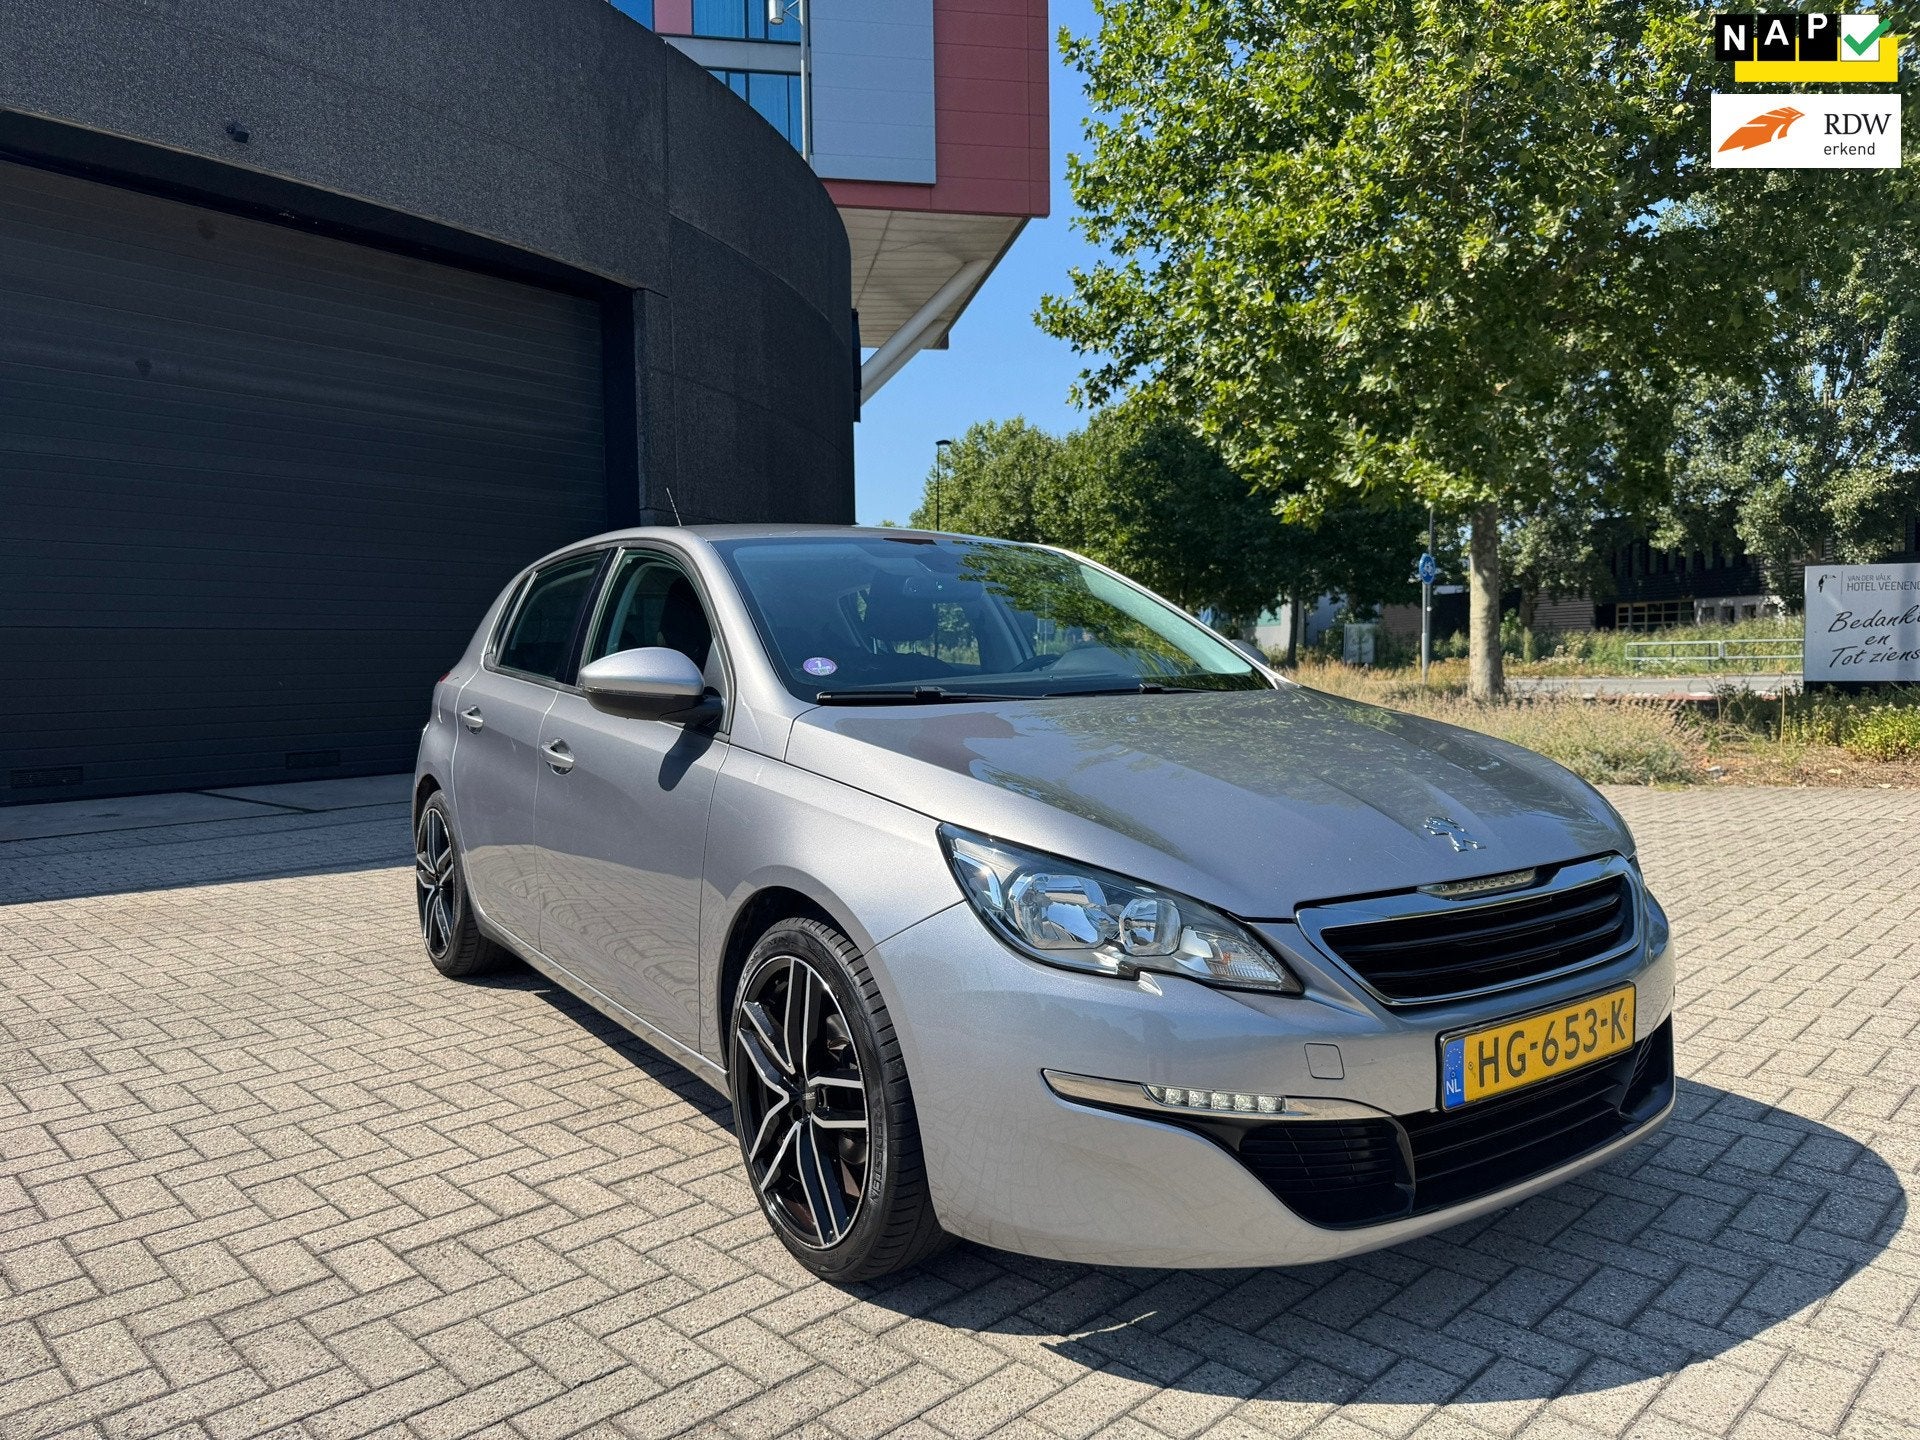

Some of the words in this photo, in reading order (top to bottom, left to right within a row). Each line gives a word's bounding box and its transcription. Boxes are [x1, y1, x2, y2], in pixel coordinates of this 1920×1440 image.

[1847, 581, 1876, 591] HOTEL
[1865, 634, 1891, 646] en
[1829, 645, 1867, 668] Tot
[1478, 998, 1626, 1088] HG-653-K
[1446, 1080, 1461, 1095] NL
